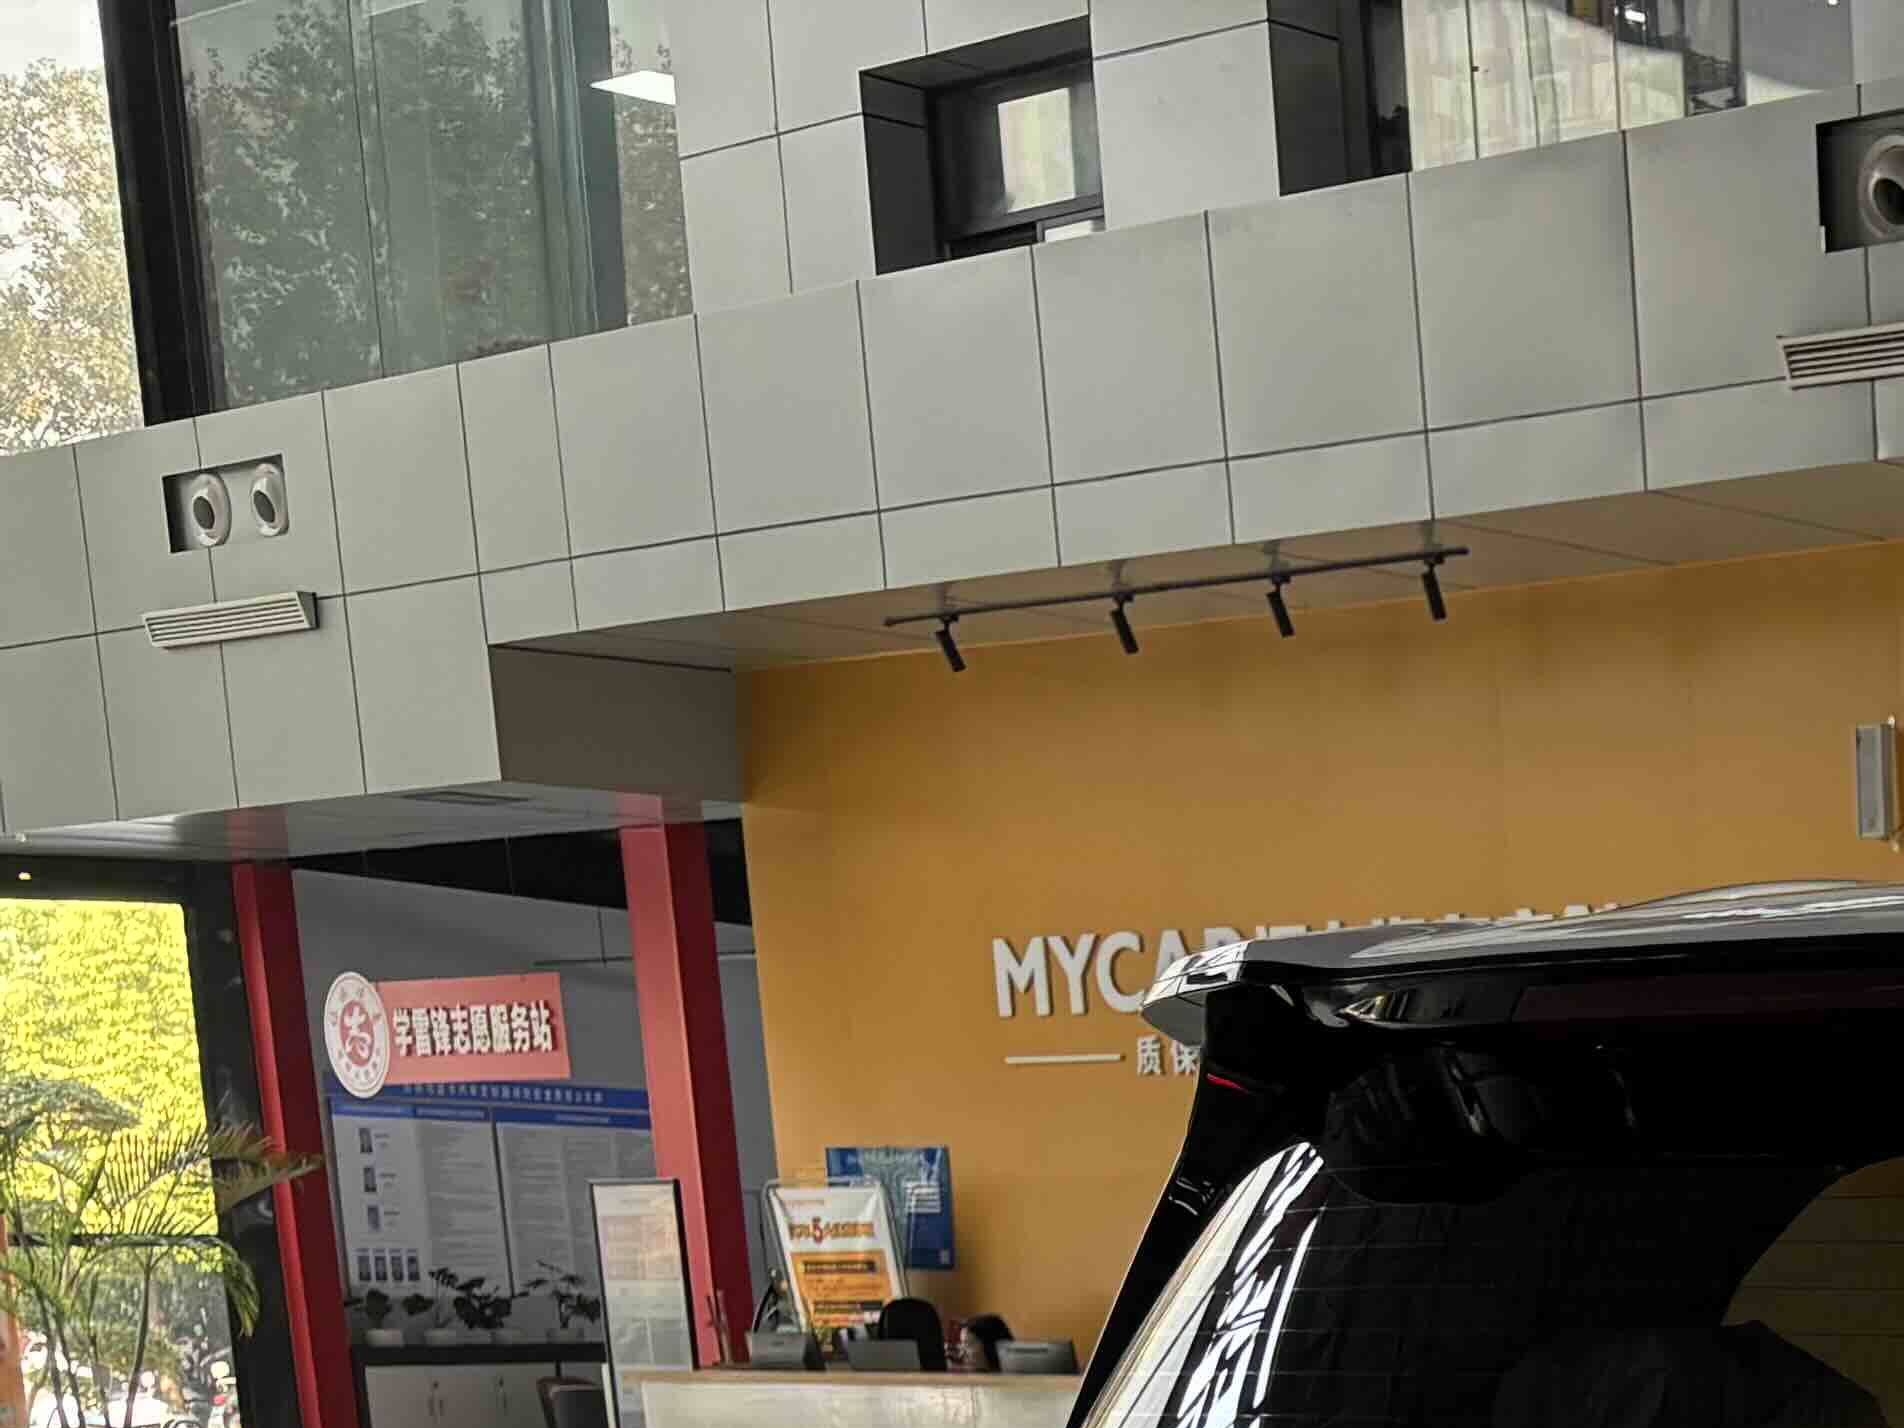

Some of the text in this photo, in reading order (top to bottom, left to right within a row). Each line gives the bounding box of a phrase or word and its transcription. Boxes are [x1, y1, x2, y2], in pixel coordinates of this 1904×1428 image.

[393, 1001, 553, 1057] 学雷锋志愿服务站
